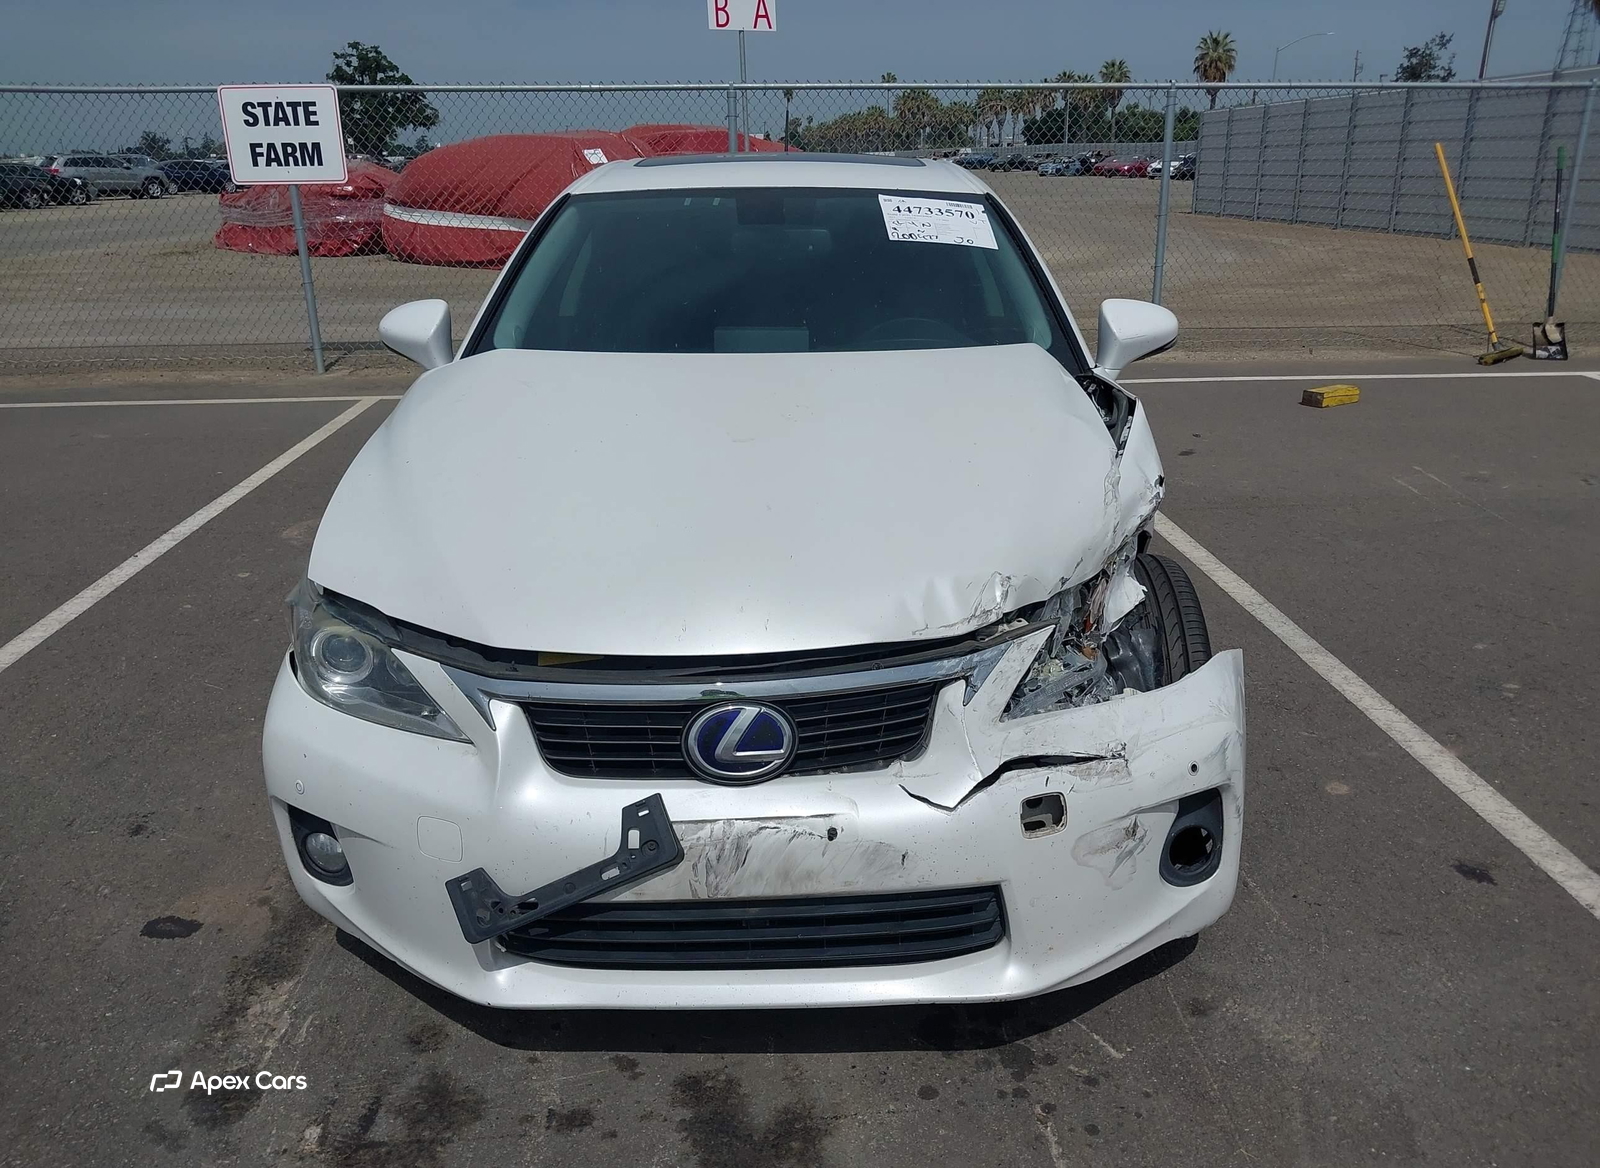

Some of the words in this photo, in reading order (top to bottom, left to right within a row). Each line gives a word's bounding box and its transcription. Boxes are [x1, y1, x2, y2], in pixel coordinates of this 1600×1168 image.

[714, 0, 730, 28] B
[753, 0, 773, 29] A
[241, 101, 320, 127] STATE
[249, 142, 324, 167] FARM
[892, 205, 975, 219] 44733570
